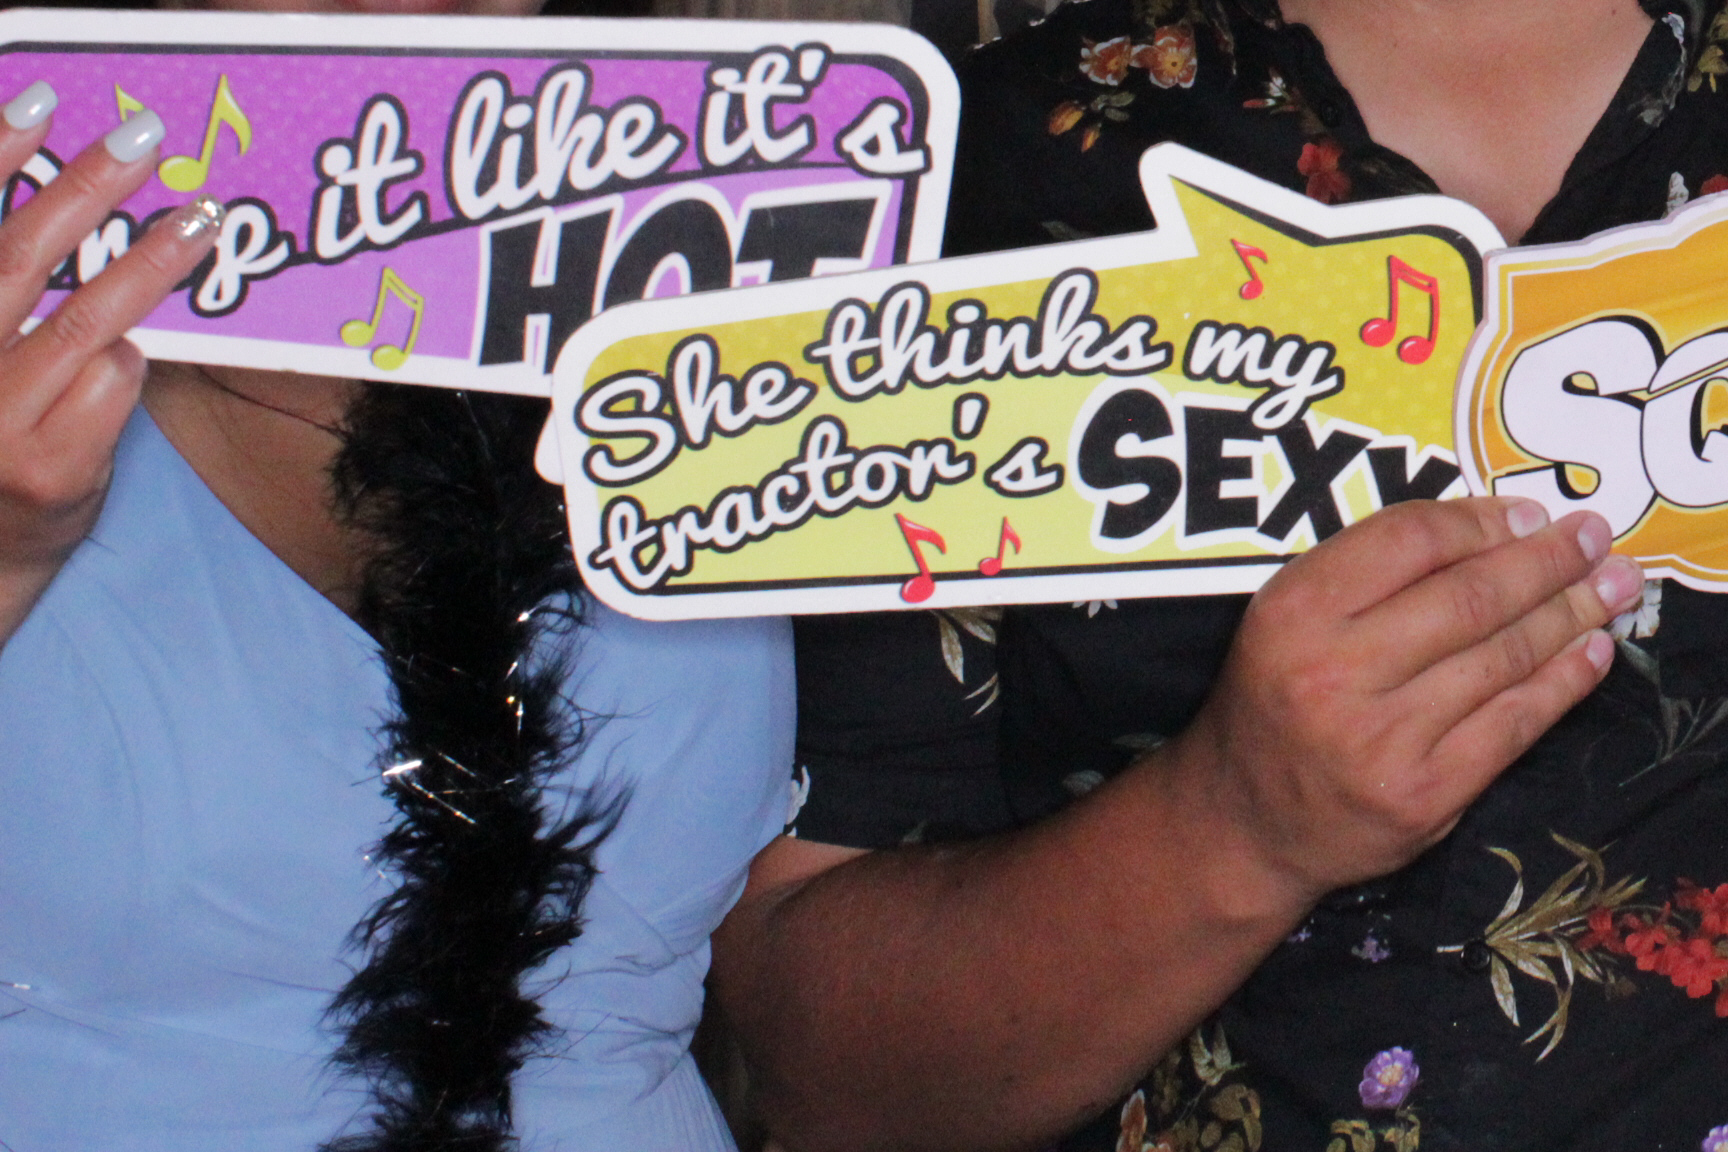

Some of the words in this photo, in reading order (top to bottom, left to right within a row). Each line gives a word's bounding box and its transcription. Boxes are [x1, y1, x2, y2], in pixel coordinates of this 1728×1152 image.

[317, 101, 424, 256] it
[449, 67, 680, 218] like
[704, 47, 926, 171] it's
[579, 338, 808, 482] She
[813, 272, 1168, 398] thinks
[1194, 323, 1338, 424] my
[598, 394, 1062, 586] tractor's
